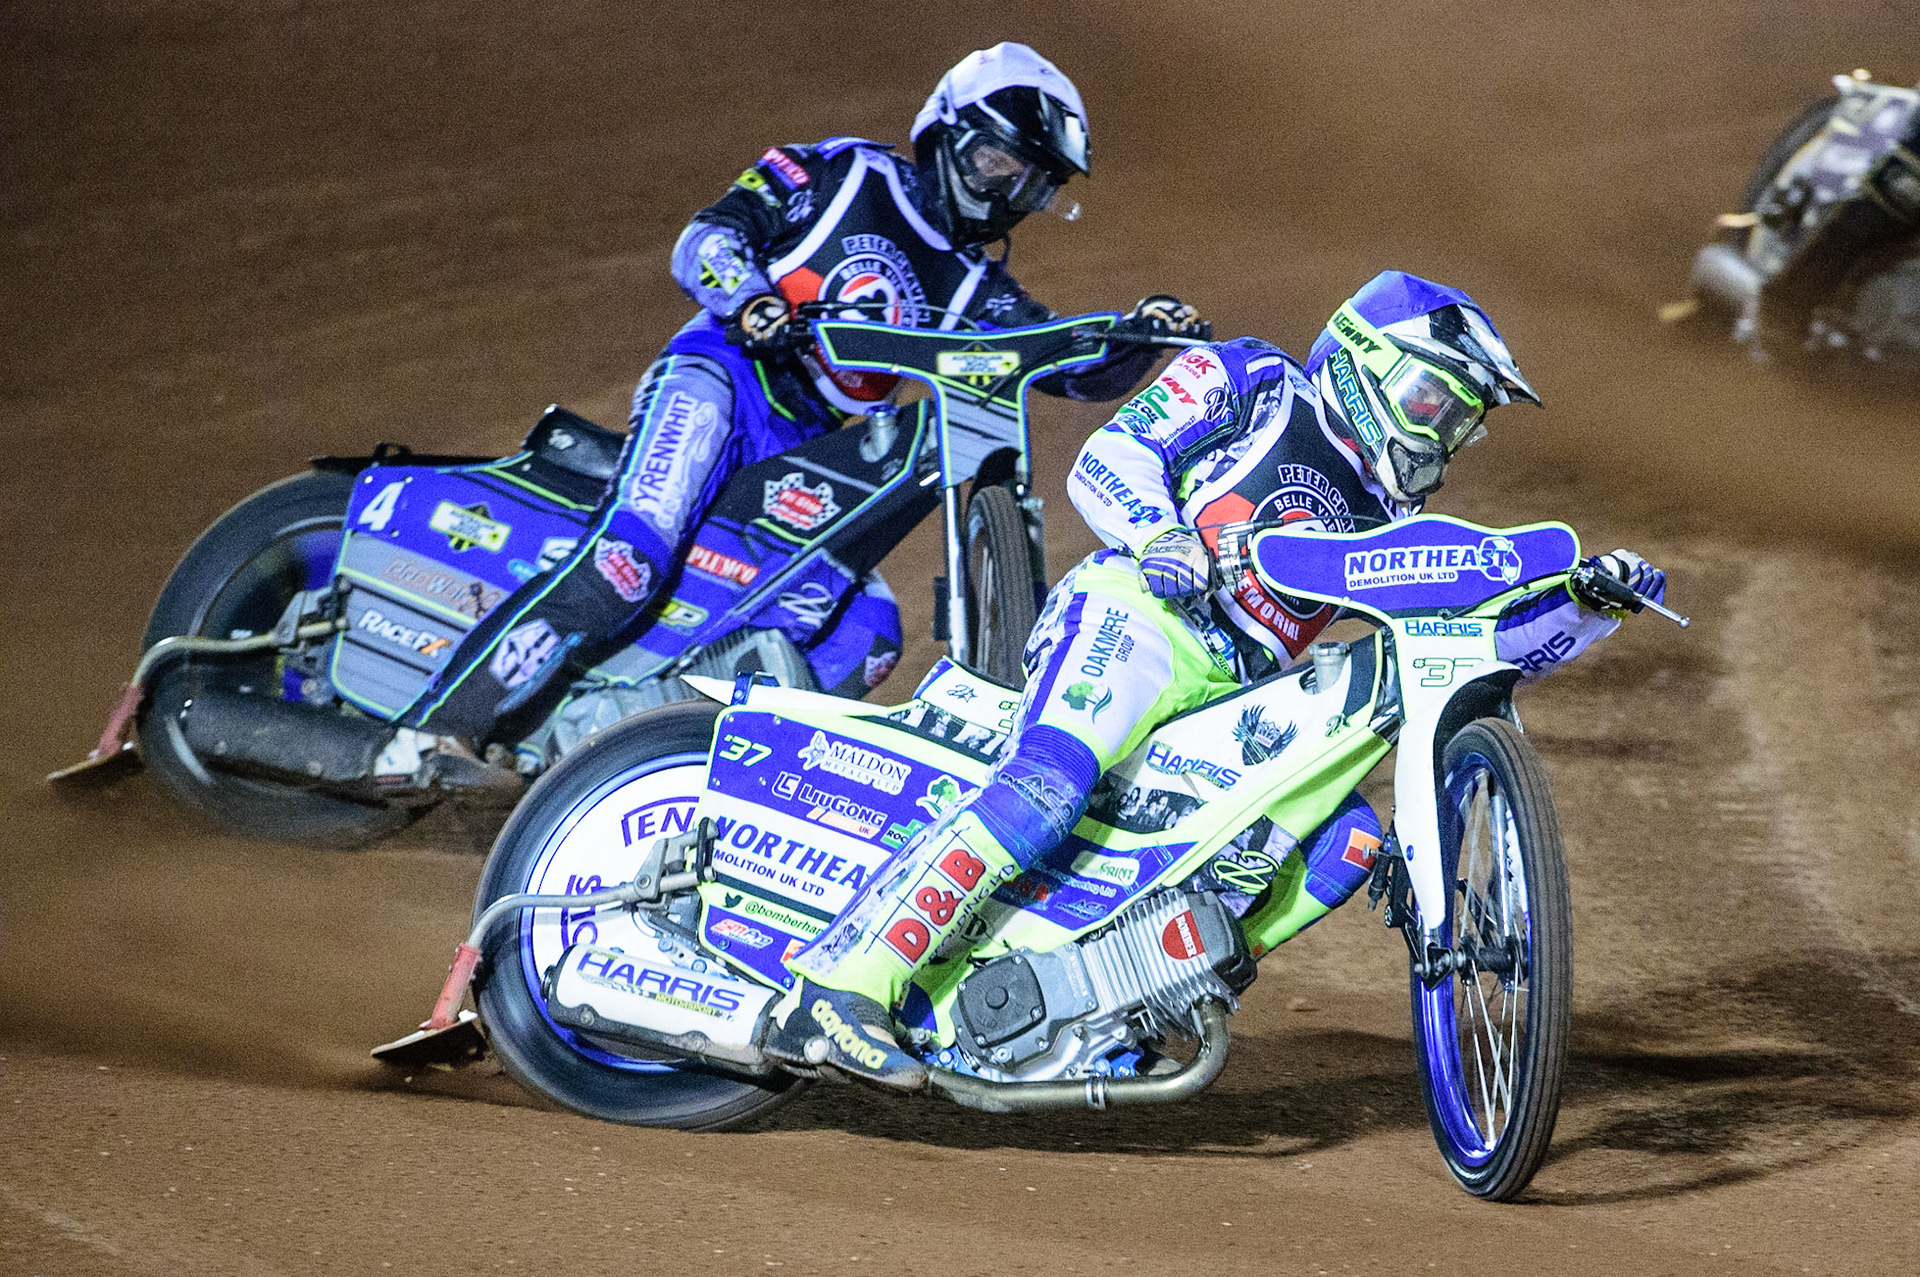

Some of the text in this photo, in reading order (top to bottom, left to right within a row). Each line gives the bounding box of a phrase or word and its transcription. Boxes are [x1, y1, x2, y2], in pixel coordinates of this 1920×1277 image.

[1330, 346, 1384, 446] HARRIS
[1278, 464, 1330, 496] PETER
[358, 481, 406, 532] 4
[1274, 494, 1312, 512] BELLE
[1348, 548, 1509, 576] NORTHEAST
[1349, 571, 1456, 588] DEMOLITION UK LTD
[1237, 575, 1300, 642] EMORIAL
[1404, 620, 1483, 636] HARRIS
[829, 745, 907, 781] MALDON
[859, 826, 870, 835] UK
[886, 829, 909, 844] ROC
[716, 815, 869, 891] NORTHEA
[713, 847, 825, 898] MOLITION UK LTD
[744, 900, 824, 936] @bomberhar
[885, 848, 986, 964] D&B
[576, 950, 745, 1012] HARRIS
